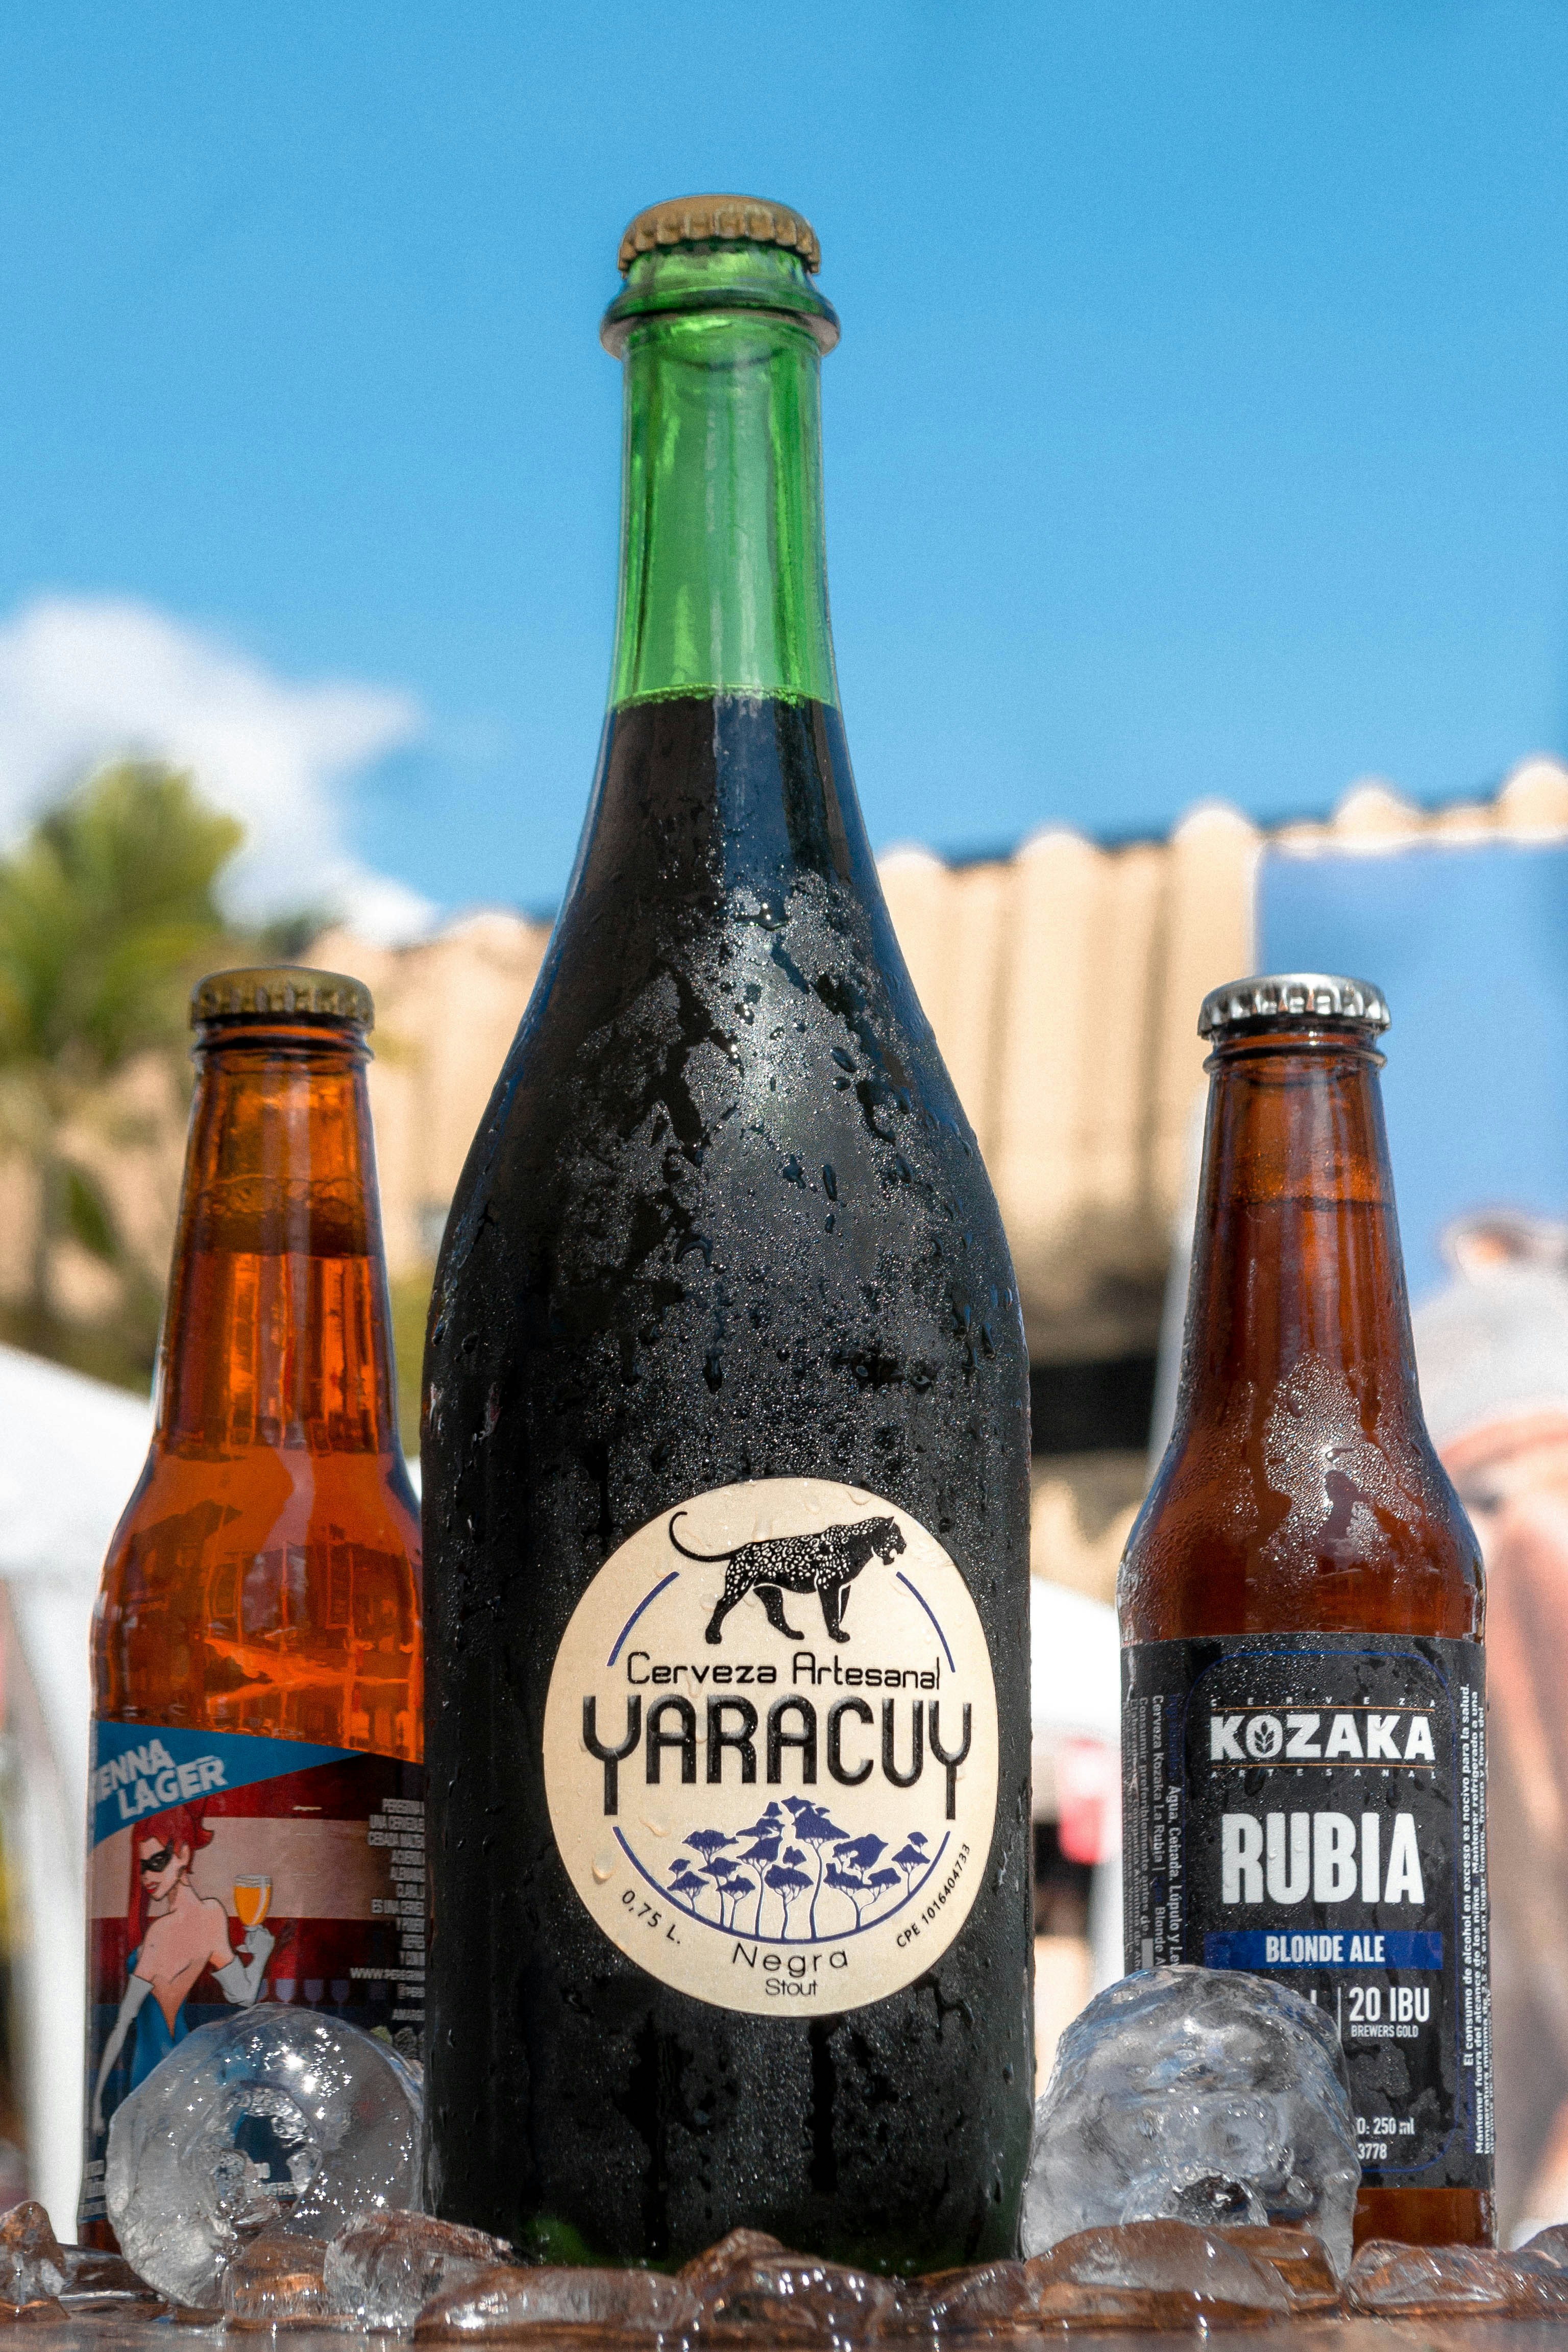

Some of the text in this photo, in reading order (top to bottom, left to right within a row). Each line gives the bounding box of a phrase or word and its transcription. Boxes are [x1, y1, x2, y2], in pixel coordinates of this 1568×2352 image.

[627, 1651, 939, 1690] Cerveza Artesanal
[1153, 1695, 1164, 1749] Cerveza
[1460, 1683, 1470, 1724] salud.
[1210, 1713, 1436, 1760] KOZAKA
[1460, 1727, 1469, 1739] la
[1472, 1720, 1478, 1729] a
[88, 1738, 176, 1803] ENNA
[582, 1694, 972, 1820] YARACUY
[1153, 1752, 1164, 1801] Kozaka
[1461, 1743, 1472, 1774] para
[1470, 1732, 1480, 1807] refrigerado
[117, 1755, 228, 1820] LAGER
[1461, 1777, 1470, 1822] nocivo
[1154, 1805, 1165, 1821] La
[1153, 1824, 1165, 1863] Rubia
[1463, 1825, 1471, 1841] es
[1471, 1810, 1479, 1874] Mantener
[1221, 1812, 1425, 1905] RUBIA
[1462, 1844, 1471, 1892] exceso
[897, 1843, 970, 1947] CPE 1016404733
[1463, 1895, 1472, 1913] en
[1472, 1887, 1480, 1924] niños
[622, 1890, 681, 1944] 0,75 L.
[1265, 1935, 1385, 1964] BLONDE ALE
[1461, 1915, 1472, 1965] alcohol
[1473, 1950, 1481, 1967] de
[732, 1942, 848, 1978] Negra
[1462, 1968, 1473, 1984] de
[765, 1977, 818, 1996] Stout
[1349, 1987, 1381, 2022] 20
[1390, 1987, 1430, 2023] IBU
[1474, 1971, 1482, 2024] alcance
[1351, 2024, 1419, 2038] BREWERS GOLD
[1464, 1989, 1474, 2050] consumo
[1474, 2027, 1482, 2048] del
[1463, 2053, 1474, 2066] El
[1474, 2051, 1482, 2087] fuera
[1355, 2116, 1415, 2135] O: 250 ml
[1475, 2090, 1483, 2154] Mantener
